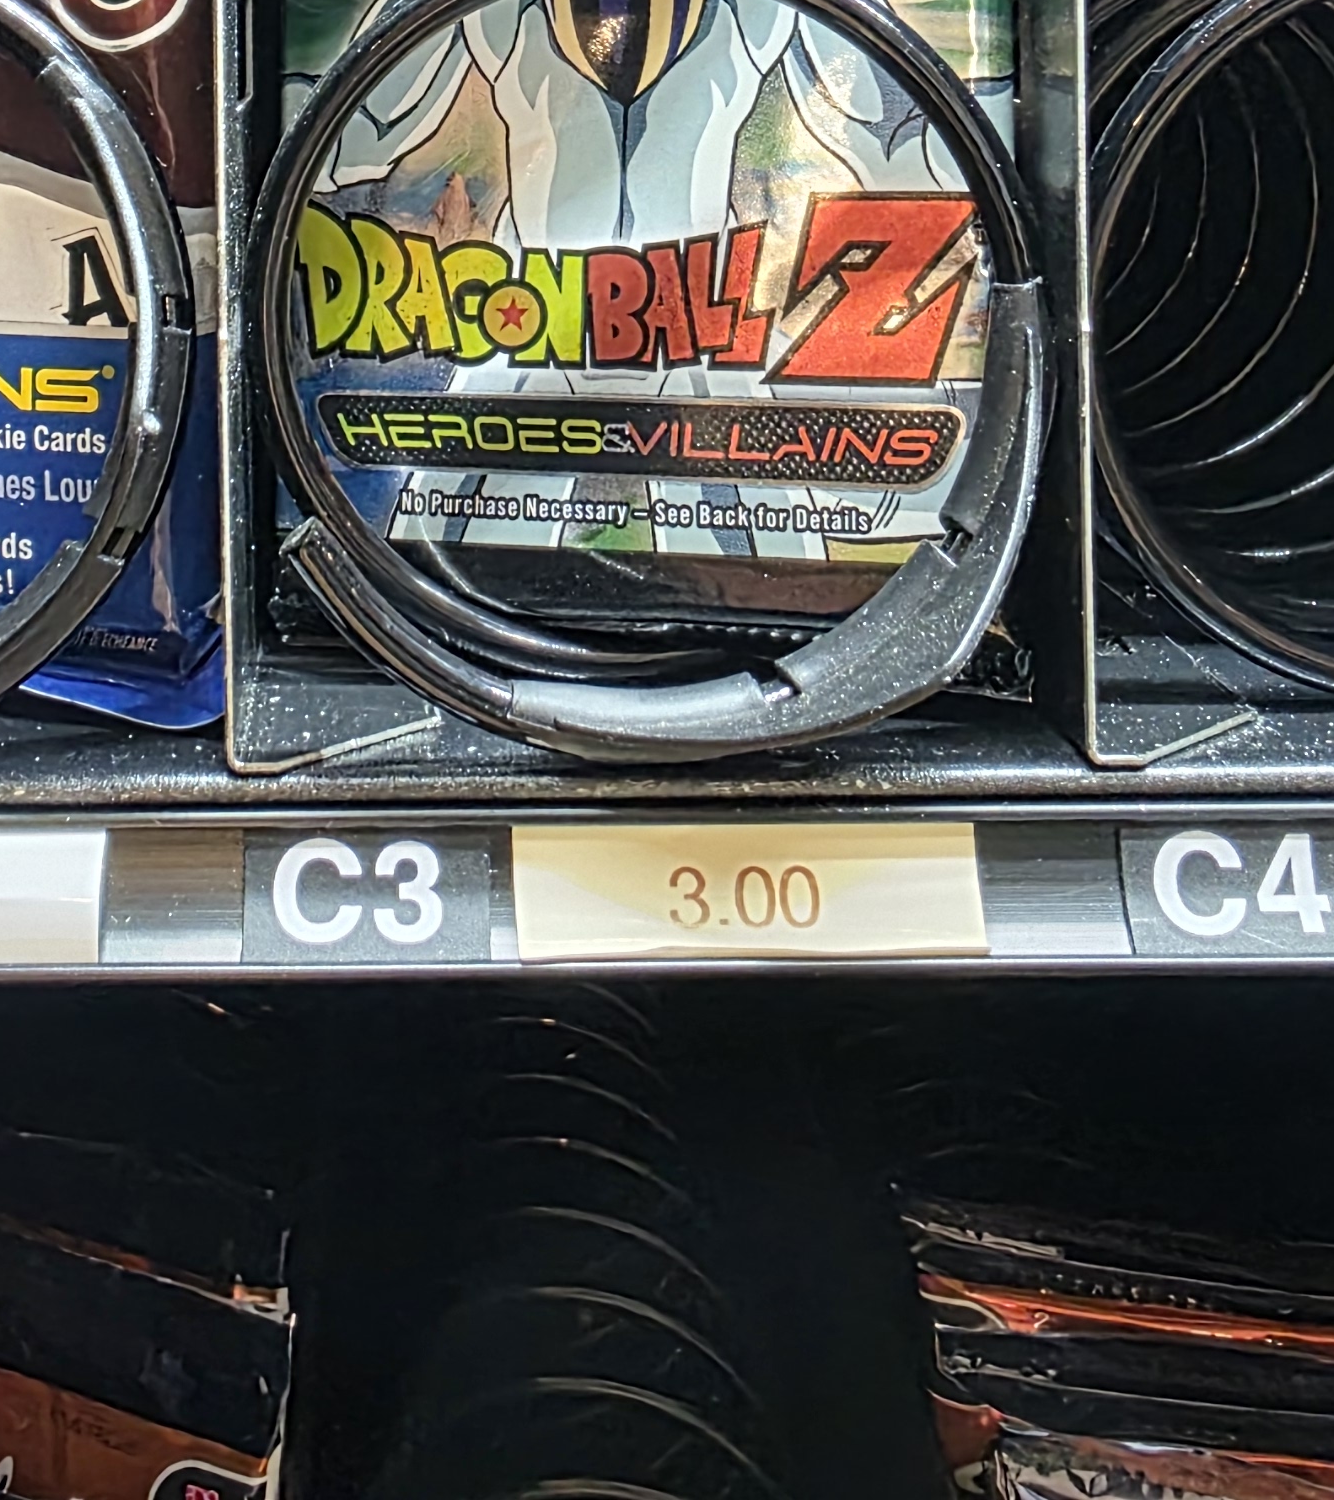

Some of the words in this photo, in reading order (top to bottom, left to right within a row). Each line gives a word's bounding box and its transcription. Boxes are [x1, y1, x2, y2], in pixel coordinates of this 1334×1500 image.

[762, 191, 978, 387] Z
[34, 425, 105, 454] Cards
[44, 470, 98, 503] Lou
[398, 488, 425, 516] No
[429, 490, 520, 521] Purchase
[525, 497, 630, 528] Necessary
[654, 500, 694, 526] See
[699, 504, 751, 529] Back
[755, 506, 791, 531] for
[795, 508, 870, 534] Details
[273, 838, 445, 946] C3
[667, 865, 820, 931] 3.00
[1151, 832, 1332, 938] C4
